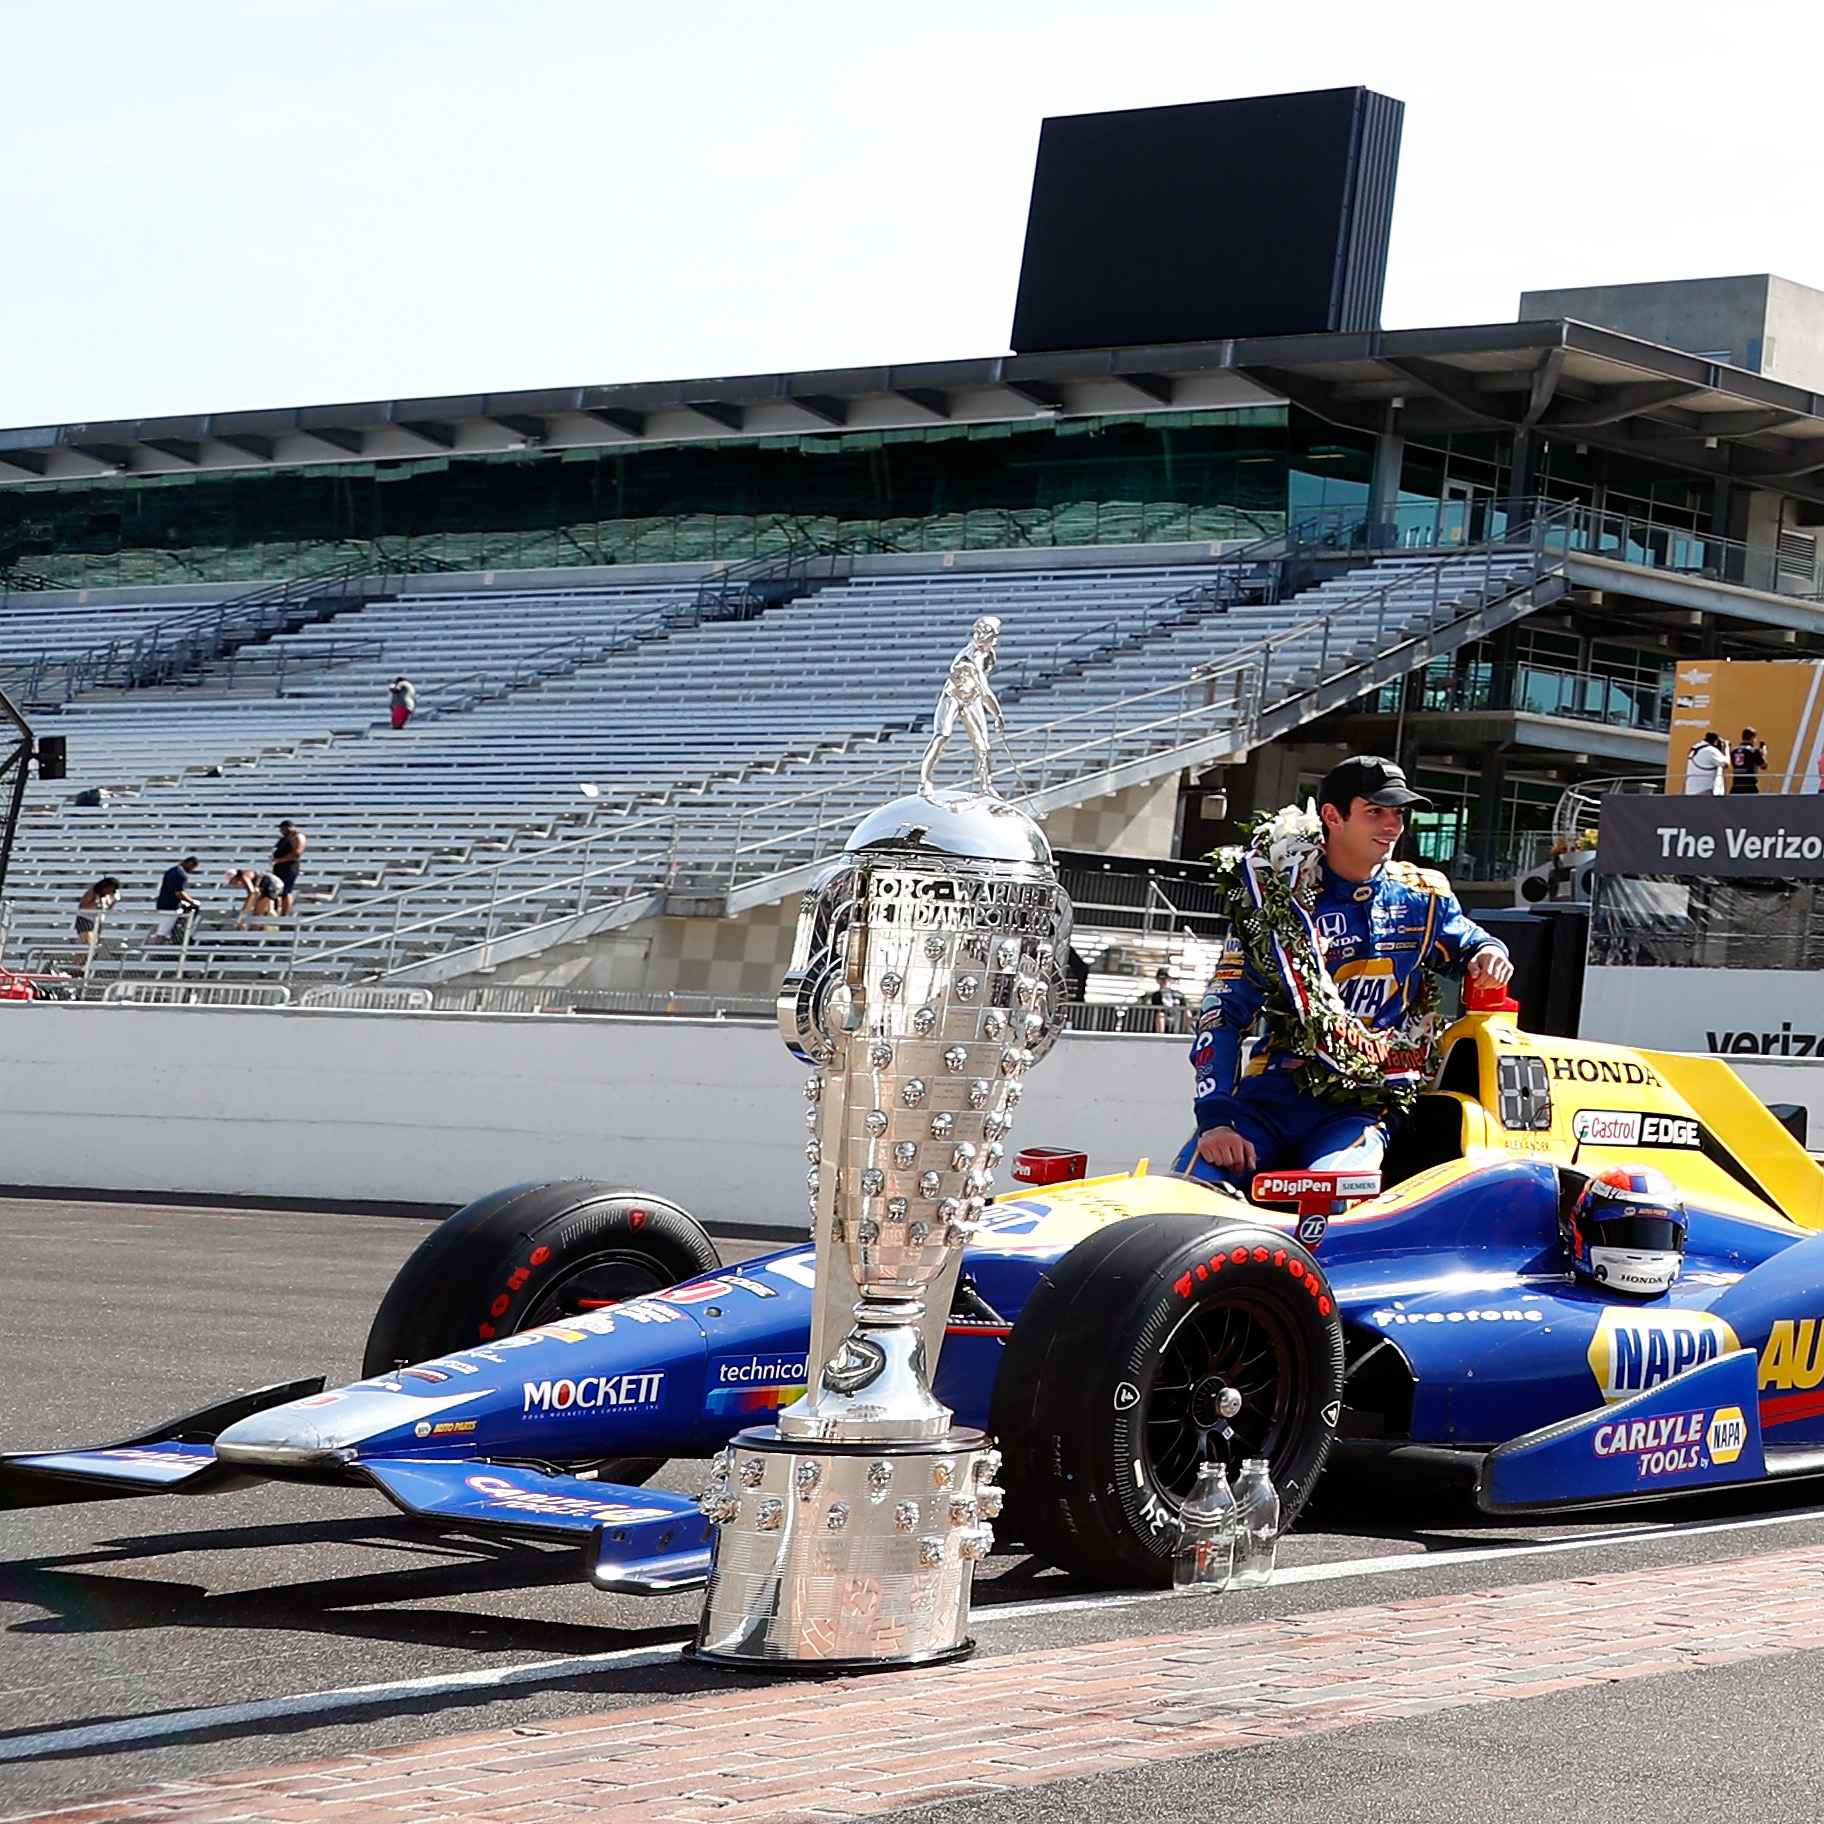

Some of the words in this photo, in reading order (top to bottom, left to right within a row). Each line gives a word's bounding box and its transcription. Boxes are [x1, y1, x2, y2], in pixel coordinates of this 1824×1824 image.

[1657, 828, 1715, 859] The
[1550, 1057, 1662, 1089] HONDA
[1504, 1140, 1551, 1152] ALEXANDER
[1592, 1116, 1637, 1140] Castrol
[1641, 1118, 1701, 1147] EDGE
[1272, 1179, 1331, 1196] DigiPen
[1342, 1181, 1376, 1191] SIEMENS
[1302, 1220, 1323, 1238] ZF
[1173, 1246, 1332, 1317] Firestone
[1620, 1273, 1663, 1285] HONDA
[1372, 1310, 1543, 1327] Firestone
[1614, 1327, 1719, 1390] NAPA
[523, 1373, 665, 1412] MOCKETT
[1594, 1413, 1705, 1456] CARLYLE
[1713, 1421, 1741, 1449] NAPA
[1640, 1445, 1701, 1476] TOOLS
[1700, 1457, 1709, 1469] by
